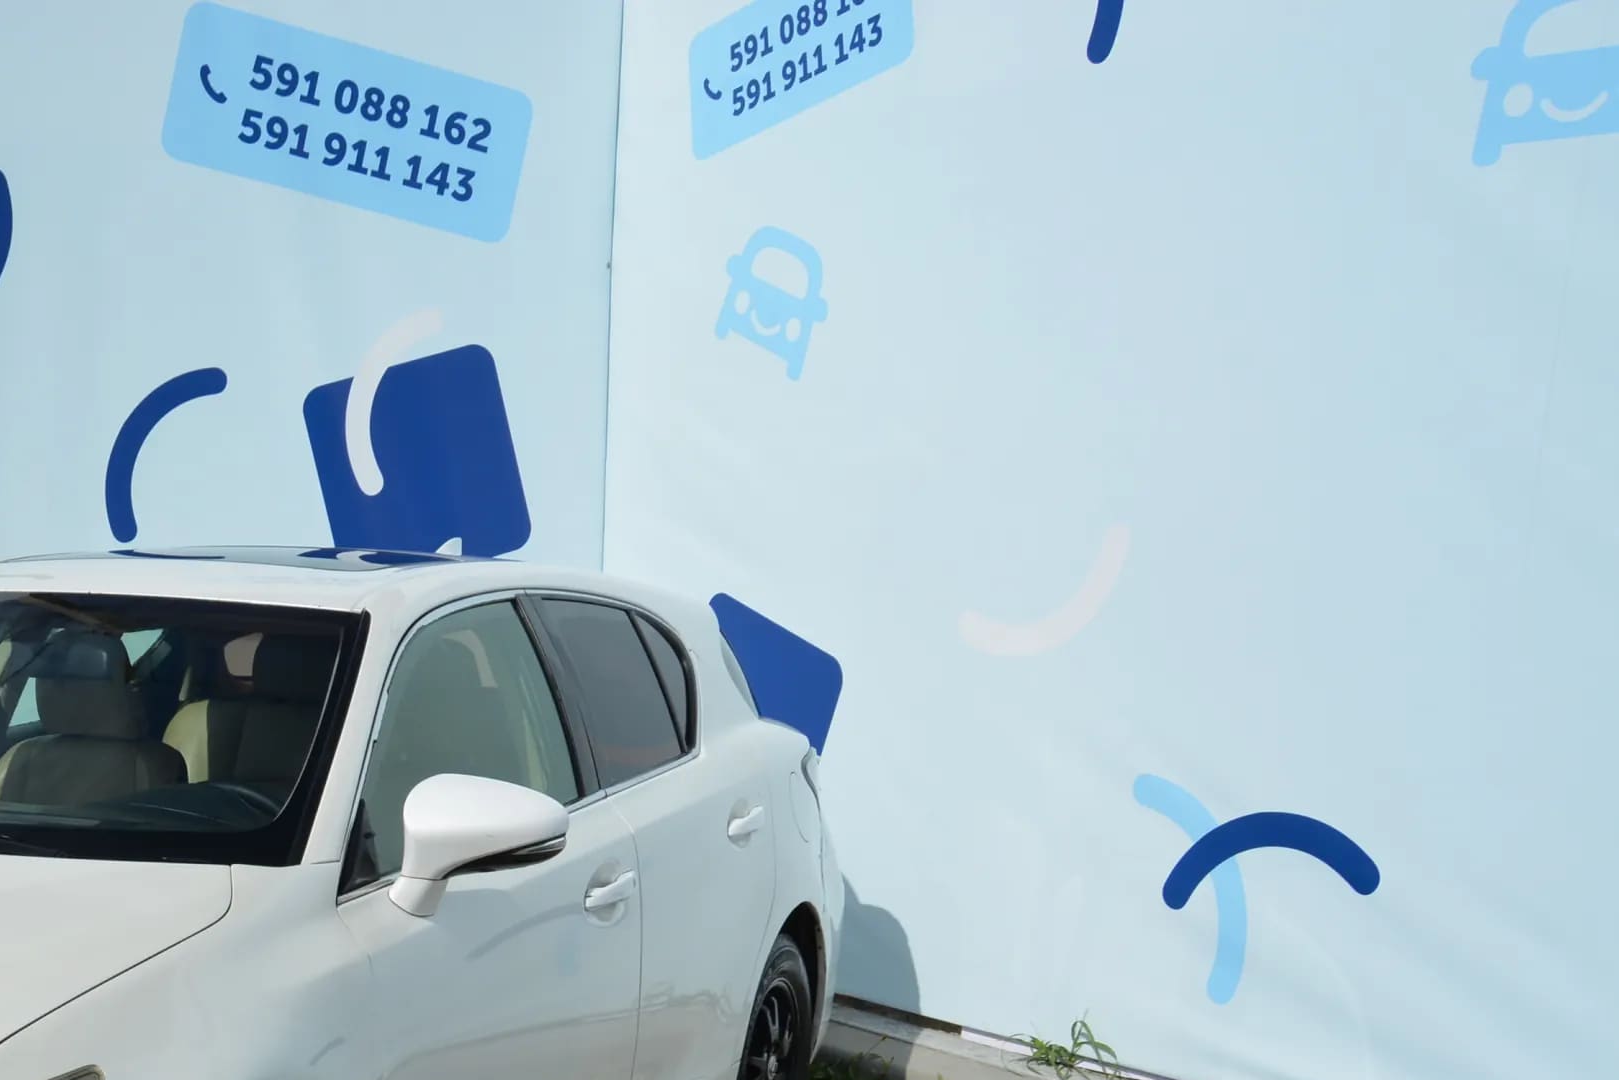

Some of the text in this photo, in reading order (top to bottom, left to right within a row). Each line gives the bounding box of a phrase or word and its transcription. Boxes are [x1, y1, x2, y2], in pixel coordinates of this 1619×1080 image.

[730, 0, 829, 73] 591 088
[732, 12, 883, 117] 591 911 143
[249, 54, 492, 154] 591 088 162
[237, 108, 476, 202] 591 911 143
